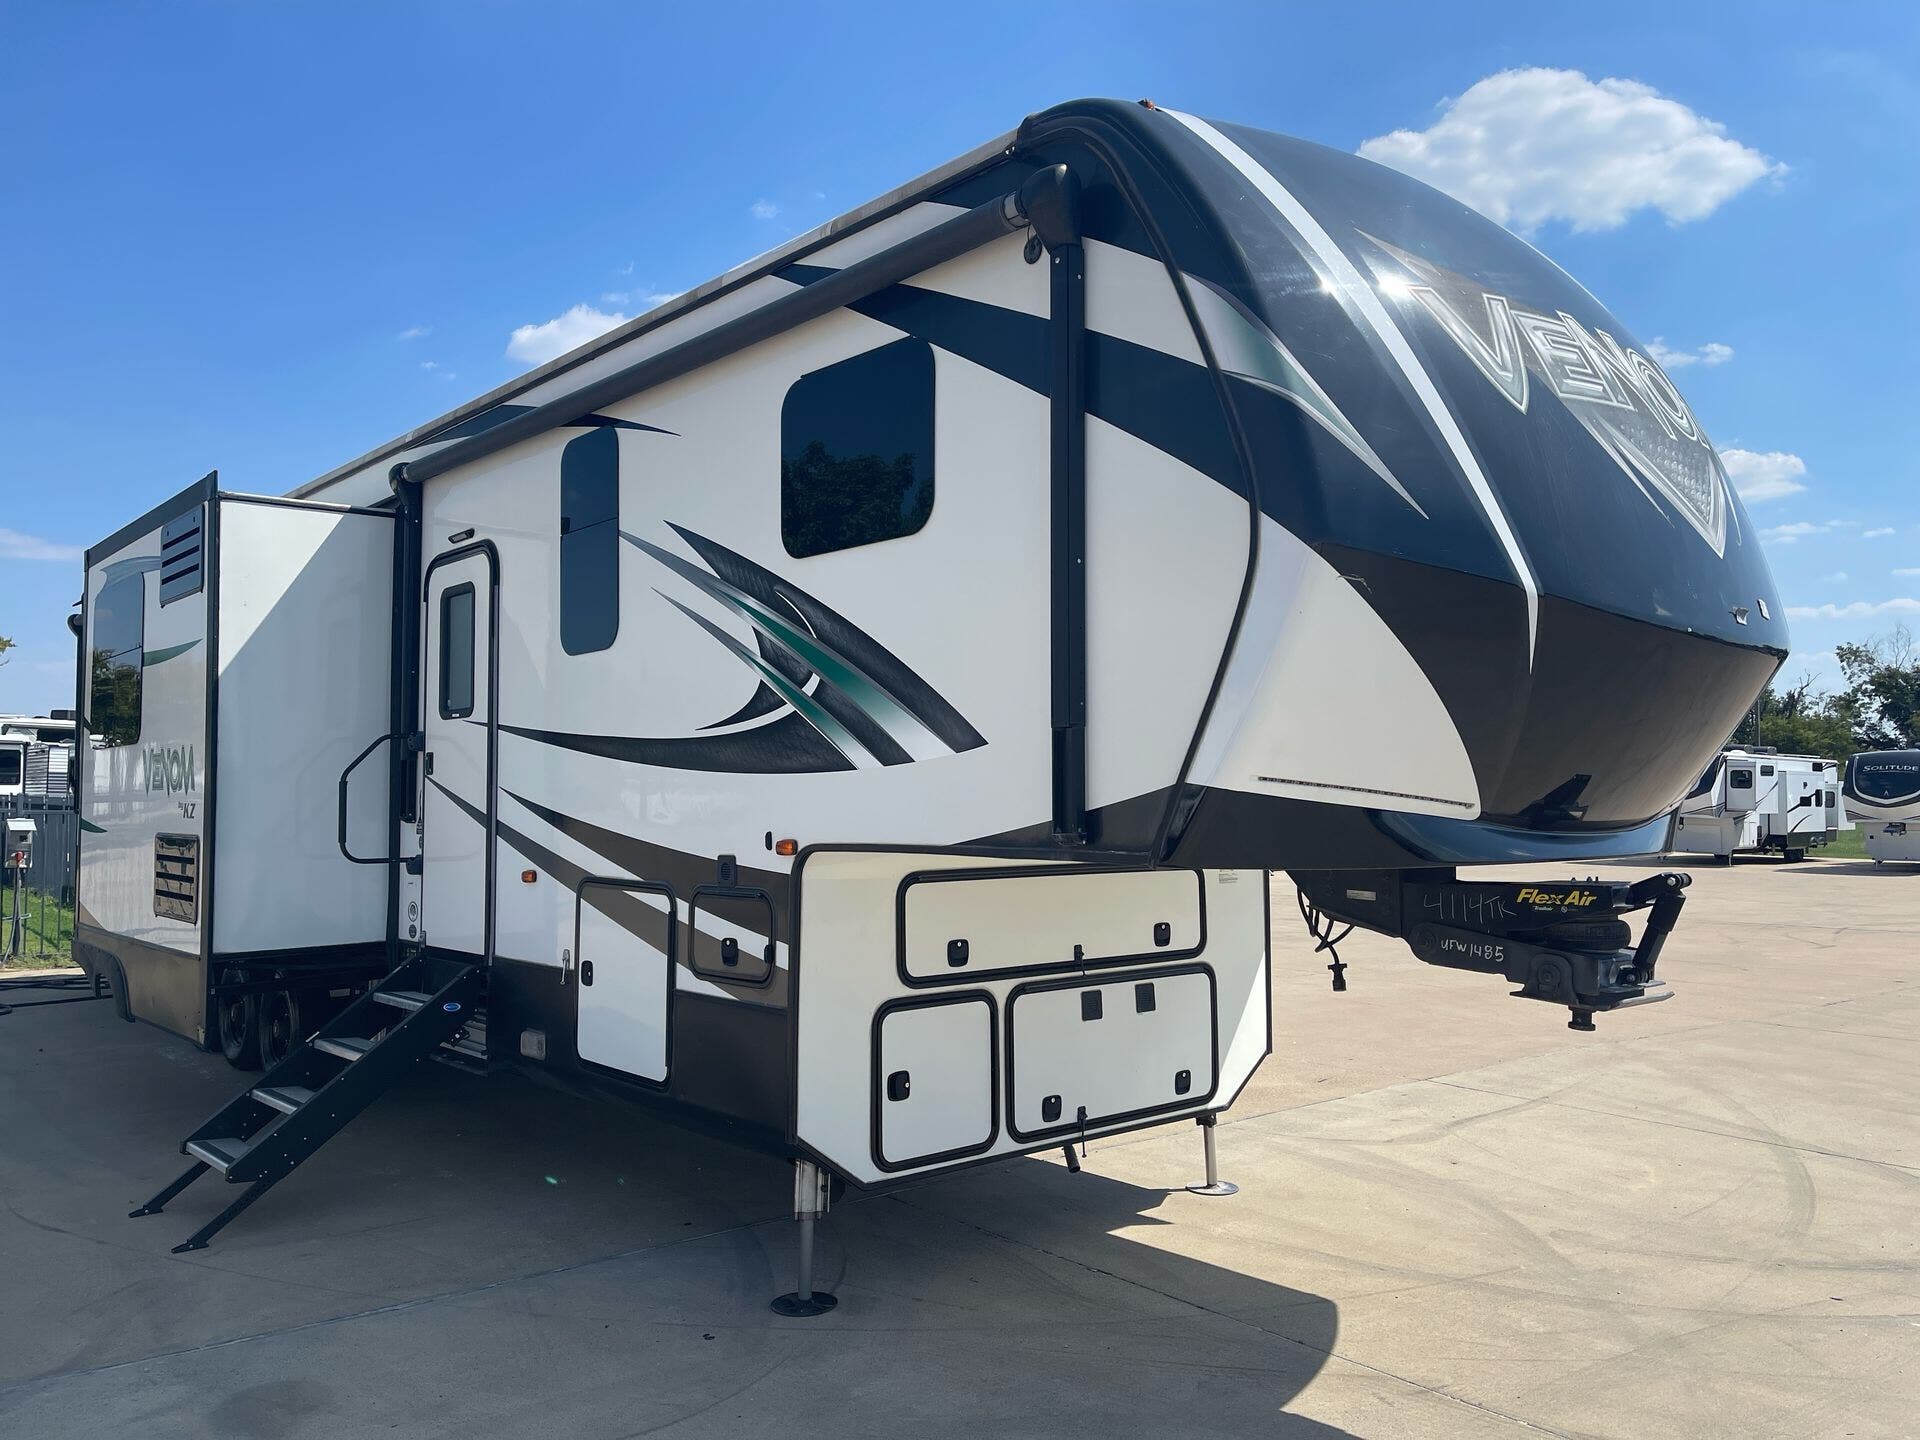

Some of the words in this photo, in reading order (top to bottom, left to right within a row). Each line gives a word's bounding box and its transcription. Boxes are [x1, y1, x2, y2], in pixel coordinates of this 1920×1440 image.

[1404, 283, 1712, 451] VENO
[142, 744, 196, 798] VENOM
[1862, 764, 1919, 772] SOLITUDE
[183, 802, 196, 819] KZ
